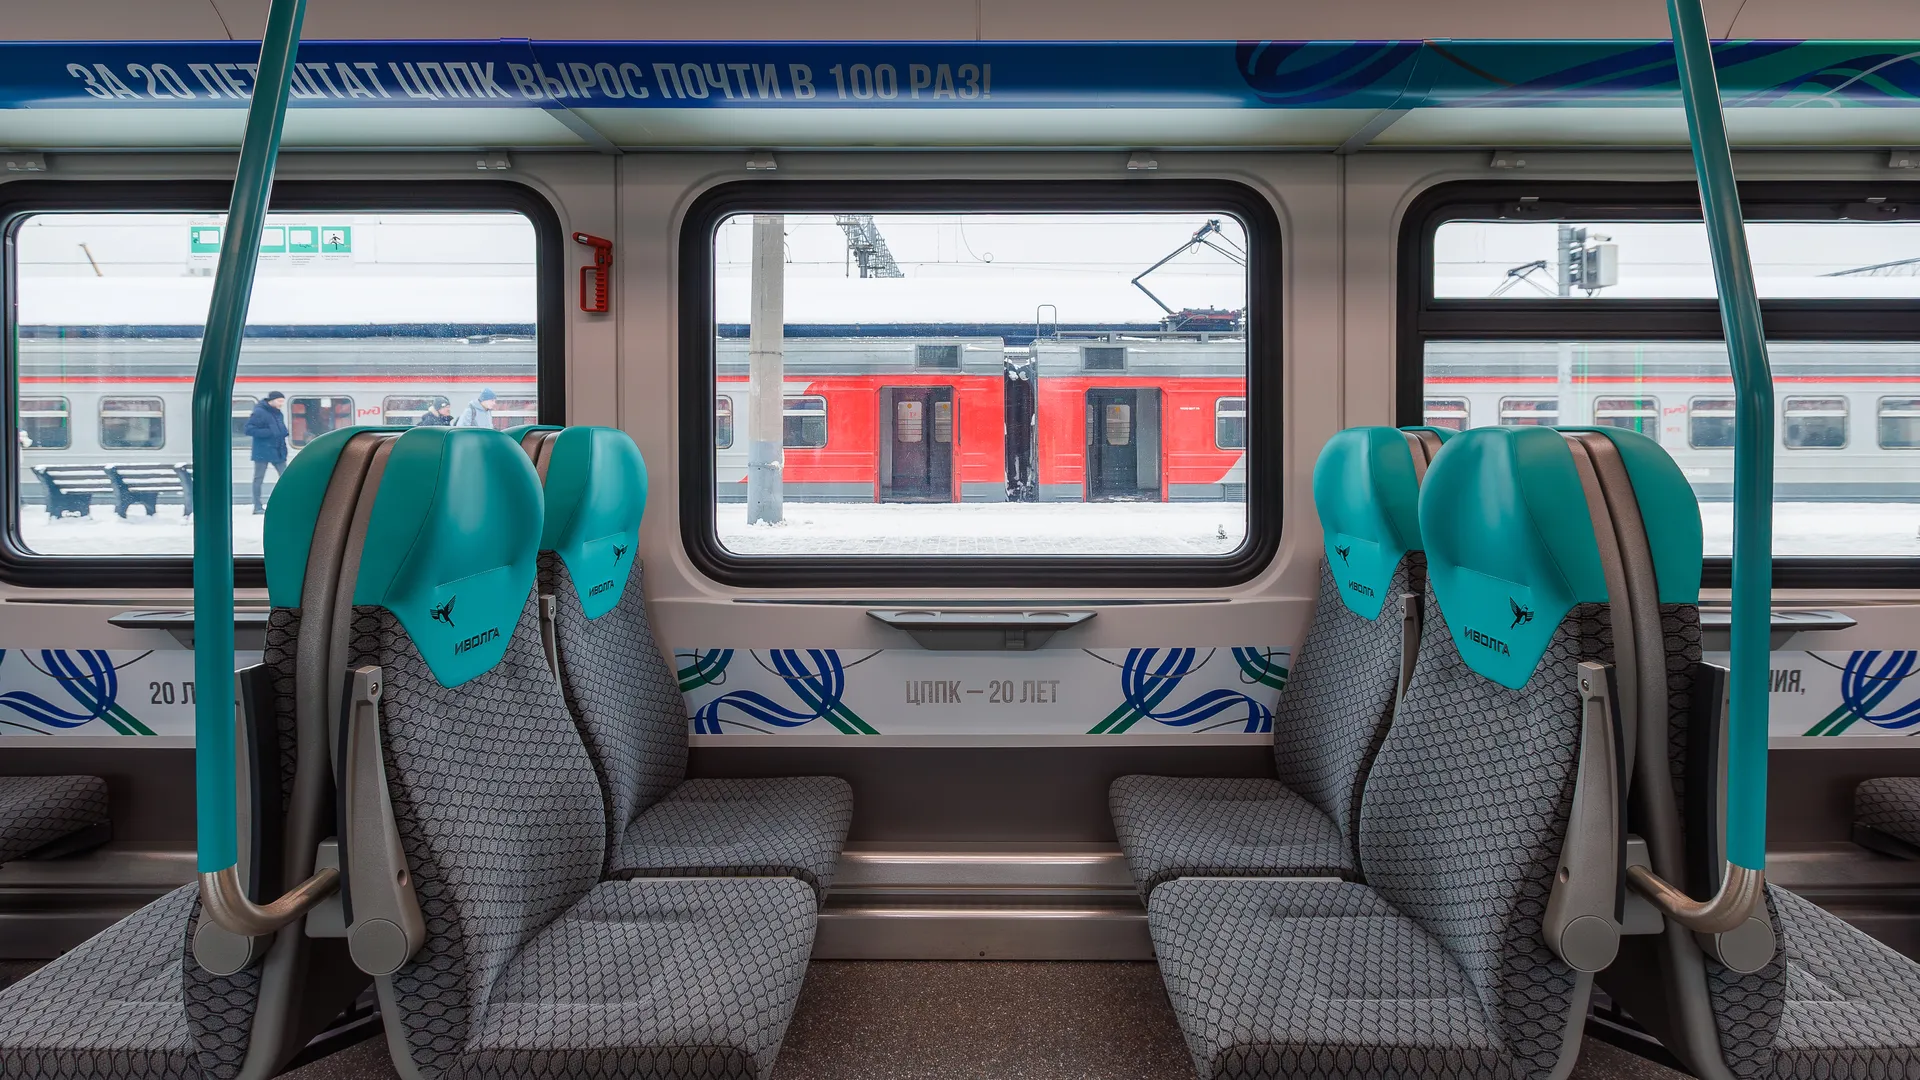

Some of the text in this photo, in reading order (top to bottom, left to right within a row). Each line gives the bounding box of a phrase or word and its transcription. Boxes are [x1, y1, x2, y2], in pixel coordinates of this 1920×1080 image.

[66, 63, 143, 99] ЗА
[126, 63, 196, 99] 20
[290, 62, 392, 98] ШТАТ
[388, 62, 512, 100] ЦППК
[507, 62, 649, 100] ВЫРОС
[652, 63, 782, 99] ПОЧТИ
[789, 63, 816, 99] В
[829, 63, 898, 99] 100
[909, 63, 991, 99] РАЗ!
[588, 579, 615, 597] ИВОЛГА
[1348, 580, 1375, 598] ИВОЛГА
[454, 626, 500, 655] ИВОЛГА
[1464, 626, 1511, 657] ИВОЛГА
[149, 681, 175, 704] 20
[906, 680, 962, 706] ЦППК
[989, 680, 1014, 704] 20
[1019, 680, 1061, 704] ЛЕТ
